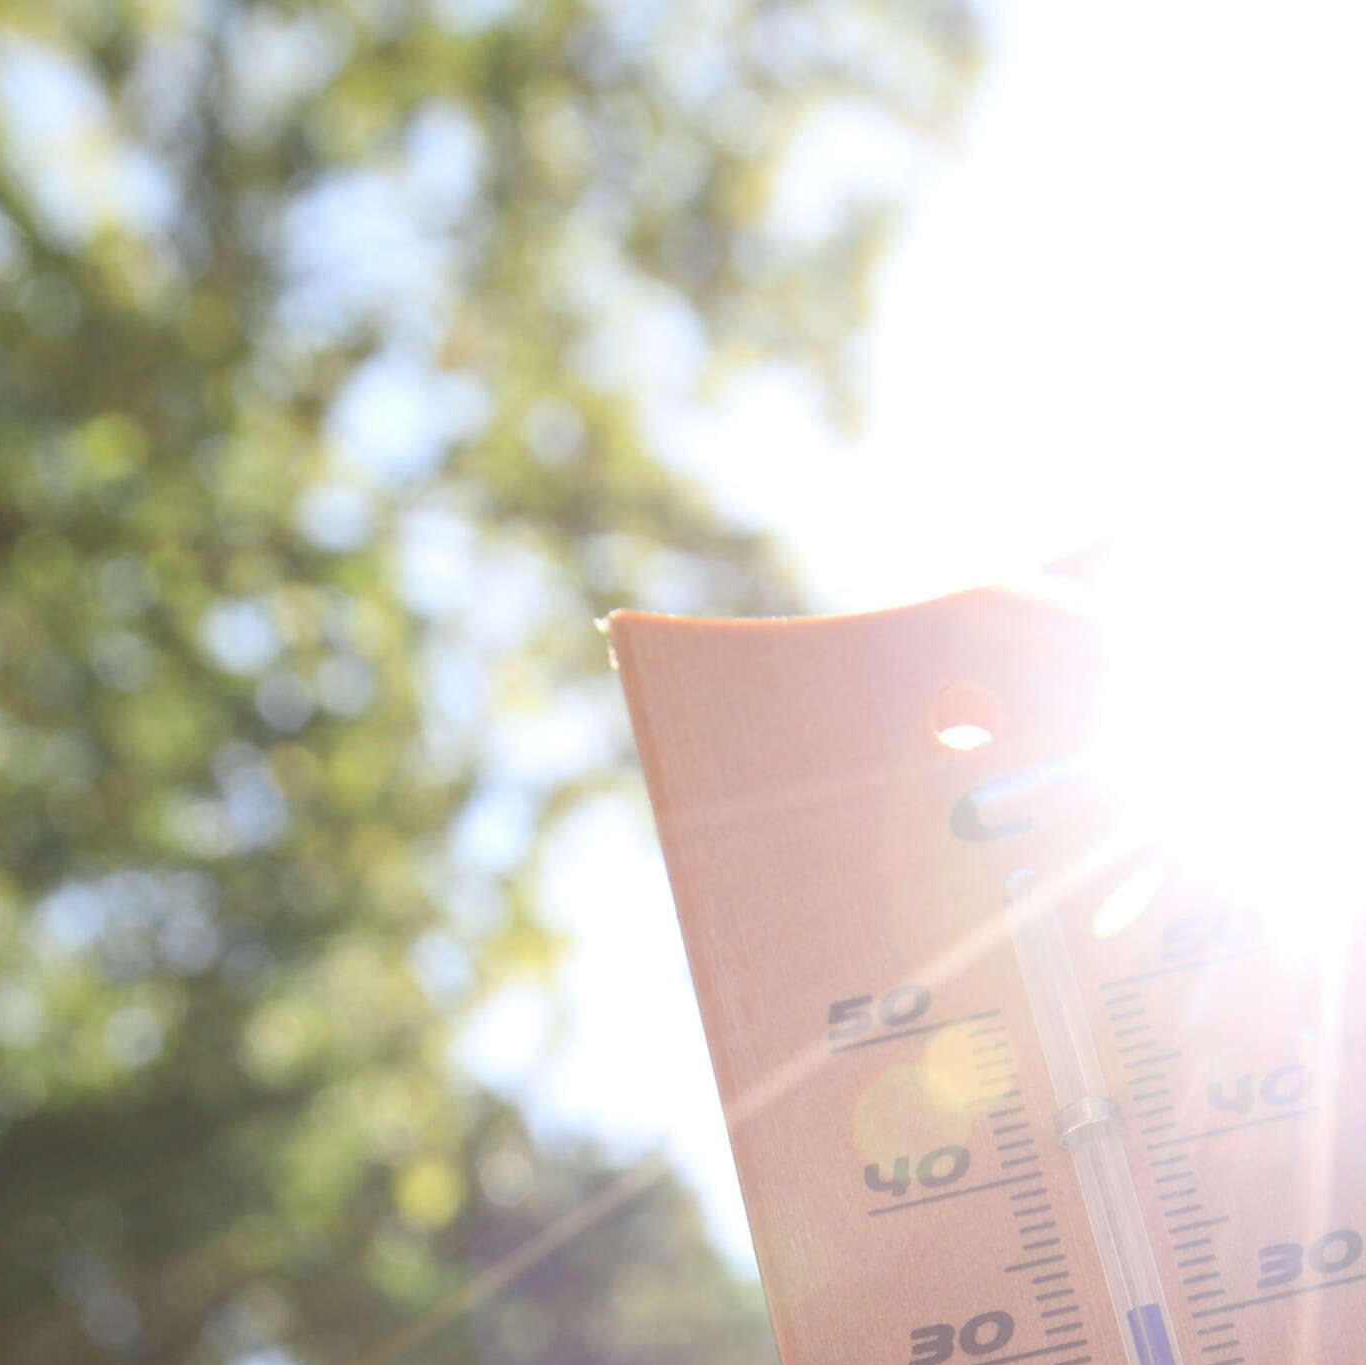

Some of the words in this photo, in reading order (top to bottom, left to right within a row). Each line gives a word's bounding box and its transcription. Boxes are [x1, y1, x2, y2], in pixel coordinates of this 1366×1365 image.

[828, 984, 931, 1044] 50
[1206, 1063, 1313, 1116] 40
[864, 1144, 971, 1197] 40
[1257, 1229, 1363, 1290] 30
